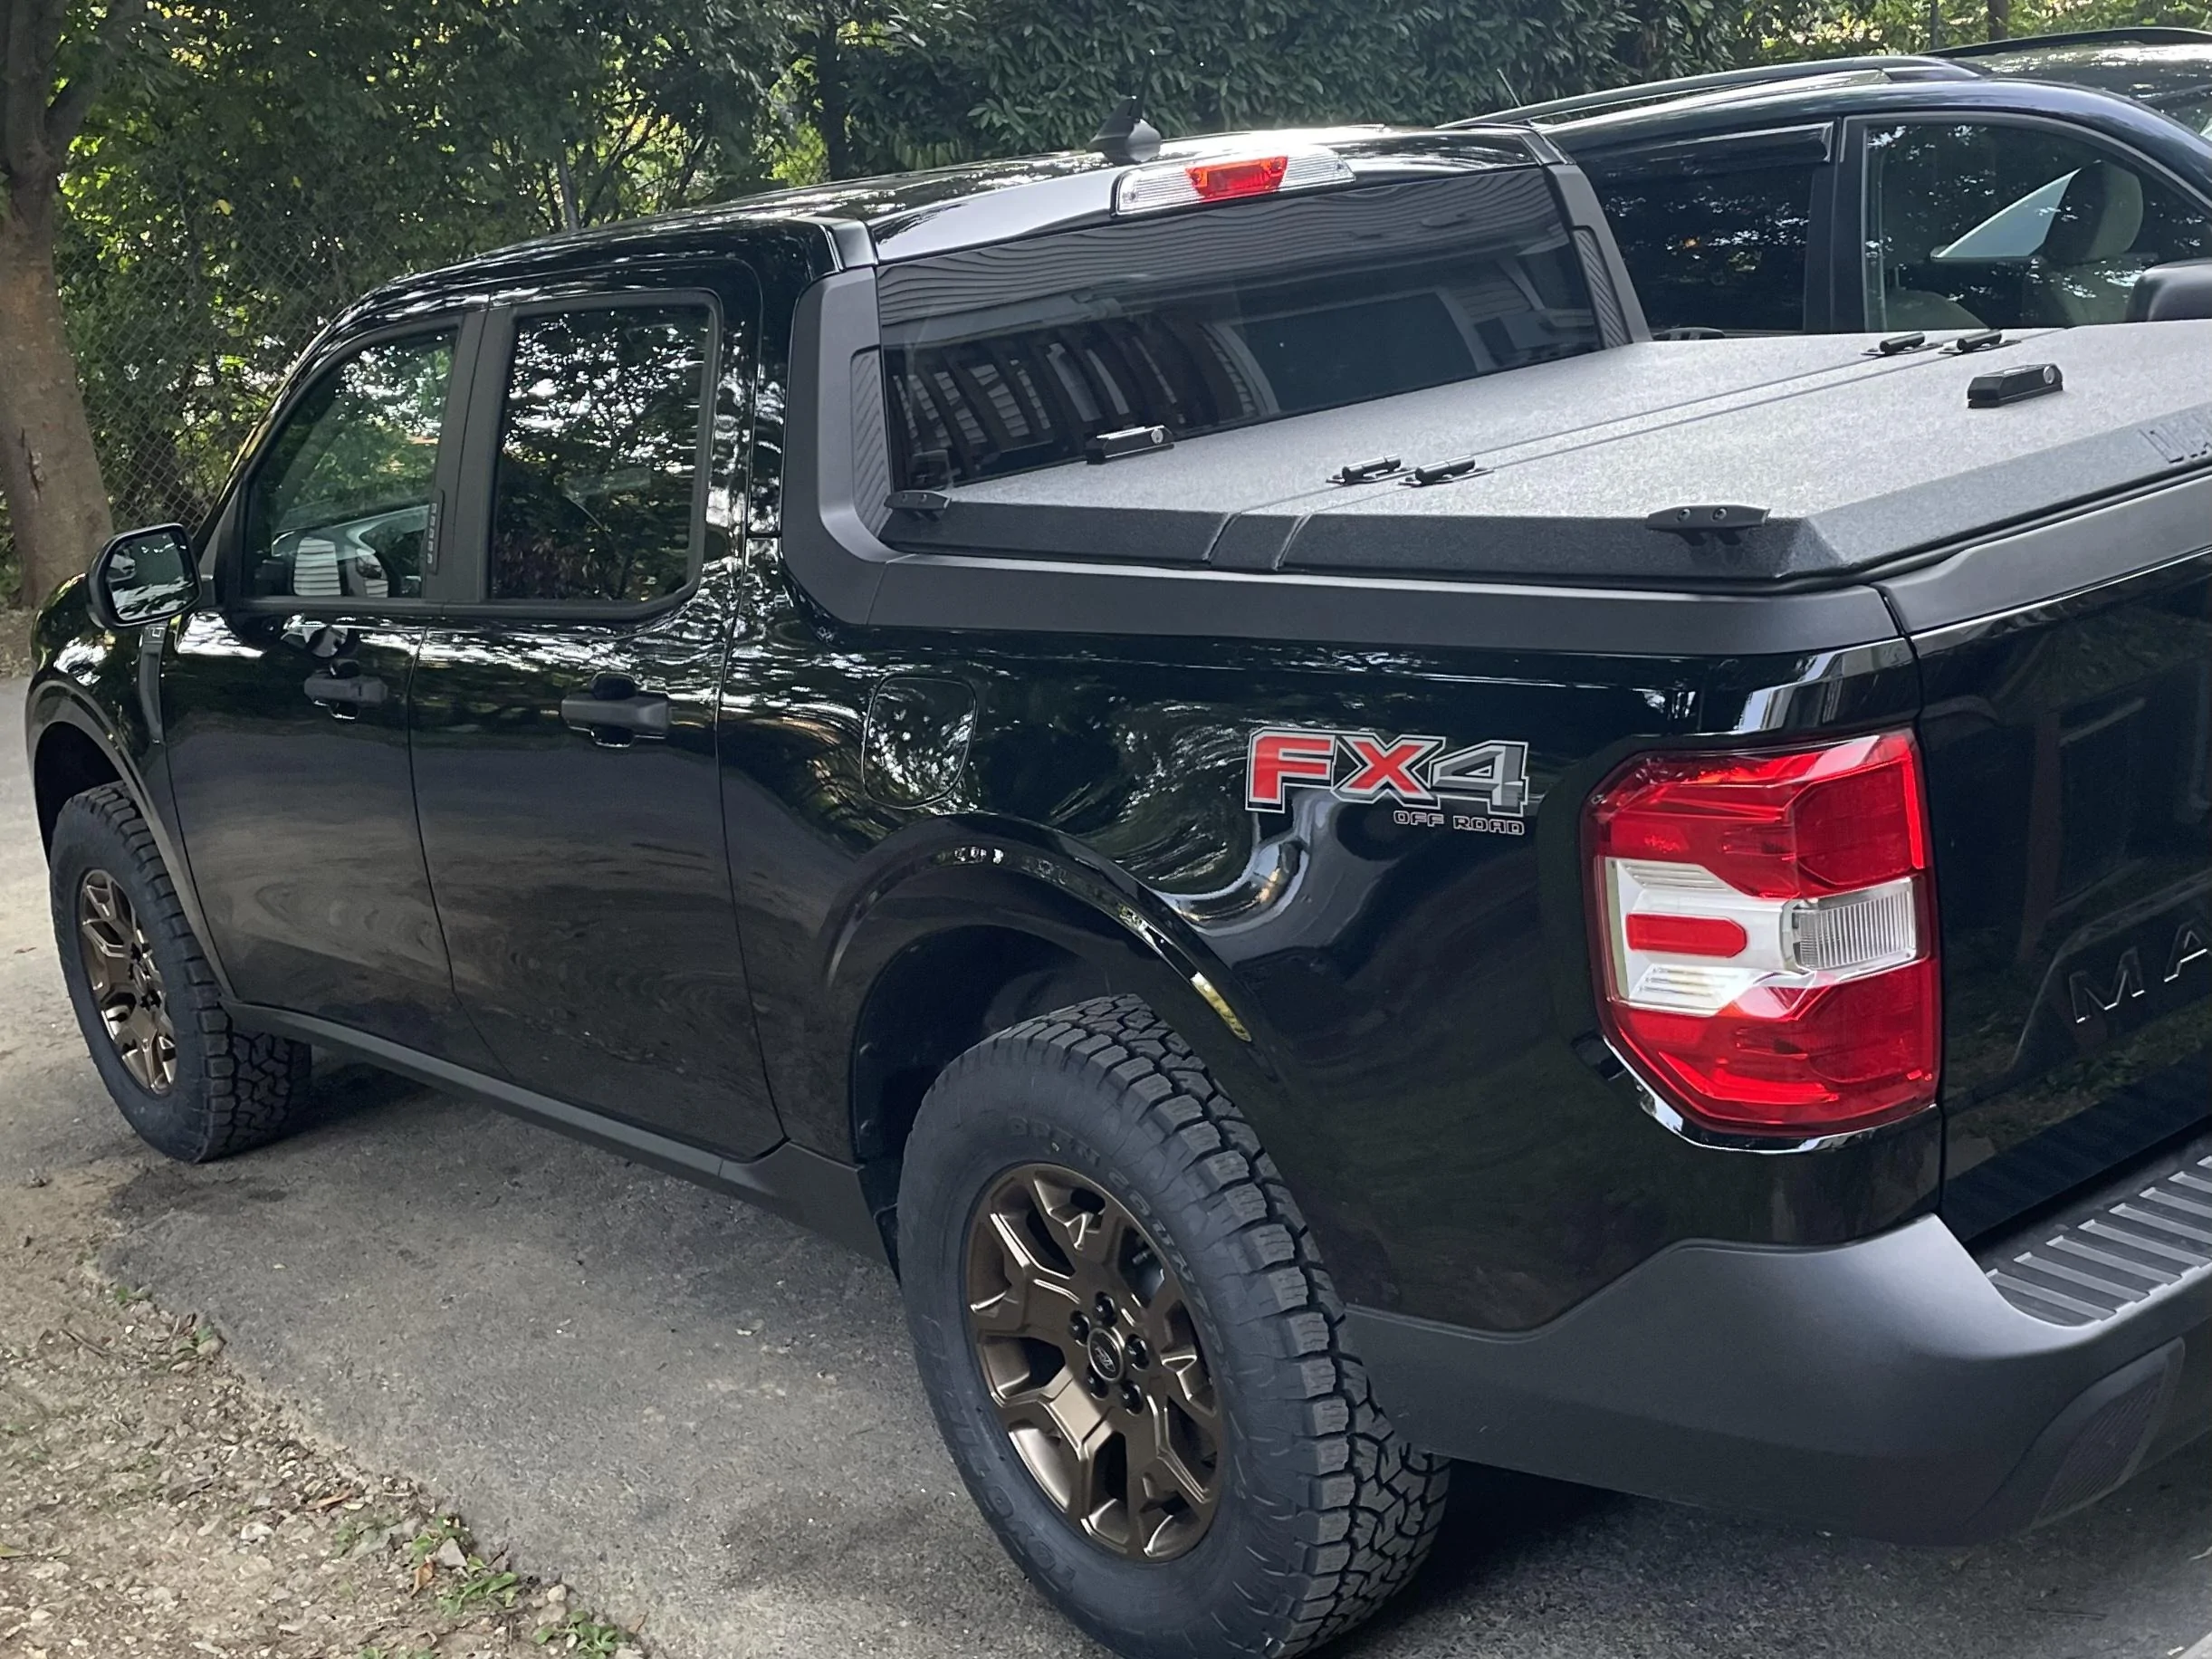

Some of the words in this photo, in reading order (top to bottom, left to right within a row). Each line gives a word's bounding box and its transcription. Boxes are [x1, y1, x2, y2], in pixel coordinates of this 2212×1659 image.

[1246, 726, 1528, 816] FX4
[1393, 810, 1445, 828] OFF
[1452, 816, 1526, 836] ROAD
